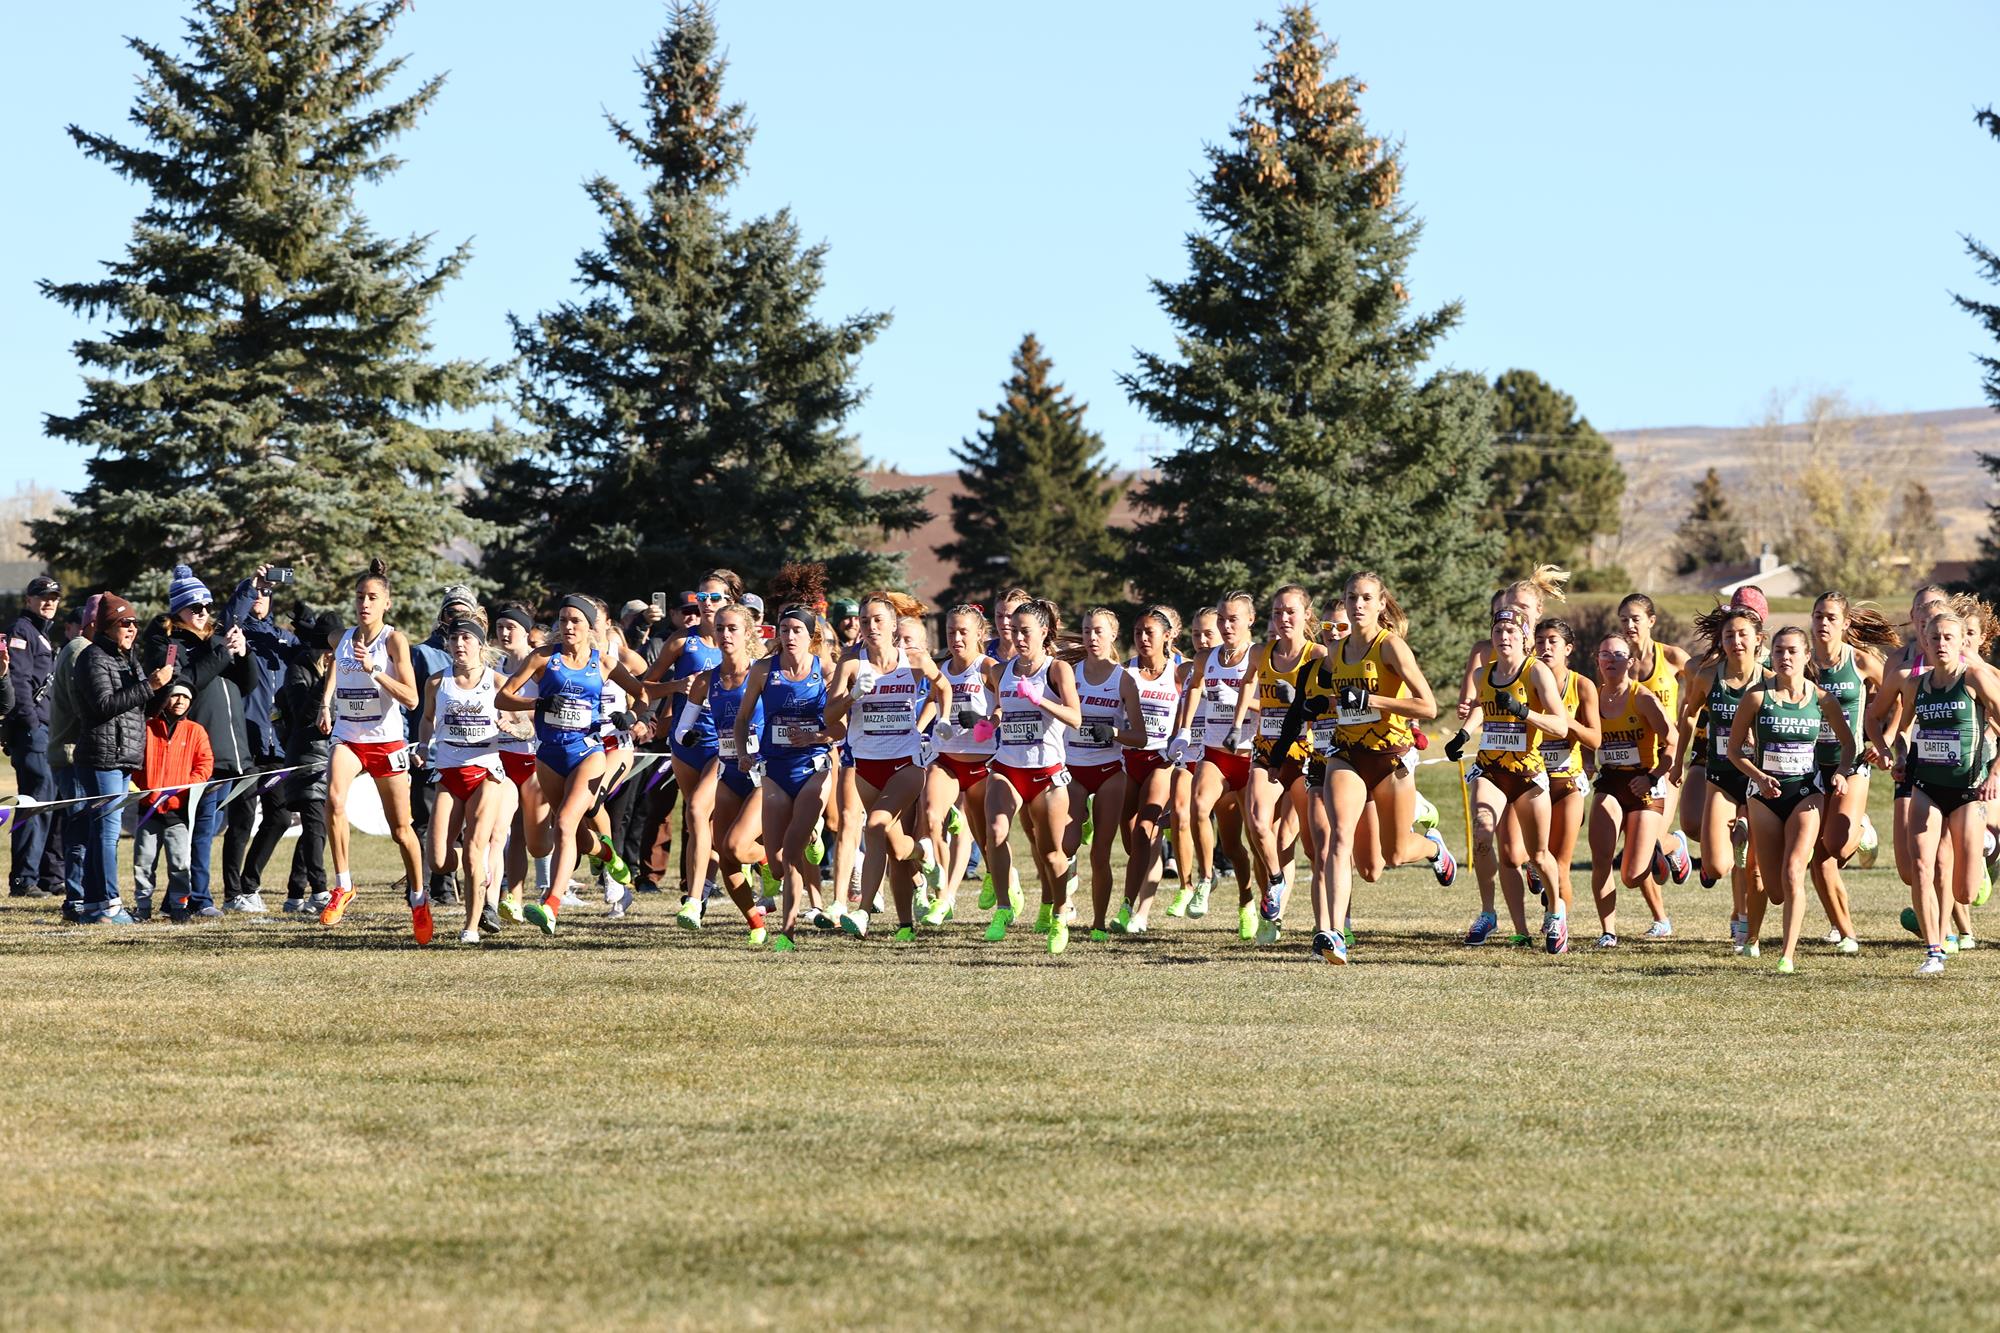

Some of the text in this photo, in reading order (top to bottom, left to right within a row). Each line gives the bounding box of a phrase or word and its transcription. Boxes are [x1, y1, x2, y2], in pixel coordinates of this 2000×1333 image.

[879, 684, 915, 694] MEXICO
[1141, 690, 1176, 702] MEXICO
[349, 701, 364, 711] RUIZ
[1085, 695, 1120, 709] MEXICO
[1915, 701, 1966, 714] COLORADO
[553, 710, 581, 721] PETERS
[863, 713, 911, 723] MAZZA-DOWNIE
[1923, 710, 1953, 720] STATE
[1759, 716, 1820, 728] COLORADO
[449, 726, 486, 737] SCHRADER
[1002, 723, 1039, 734] GOLDSTEIN
[1771, 725, 1810, 735] STATE
[1486, 734, 1520, 745] WHITMAN
[1924, 742, 1950, 753] CARTER
[1604, 750, 1630, 760] DALBEC
